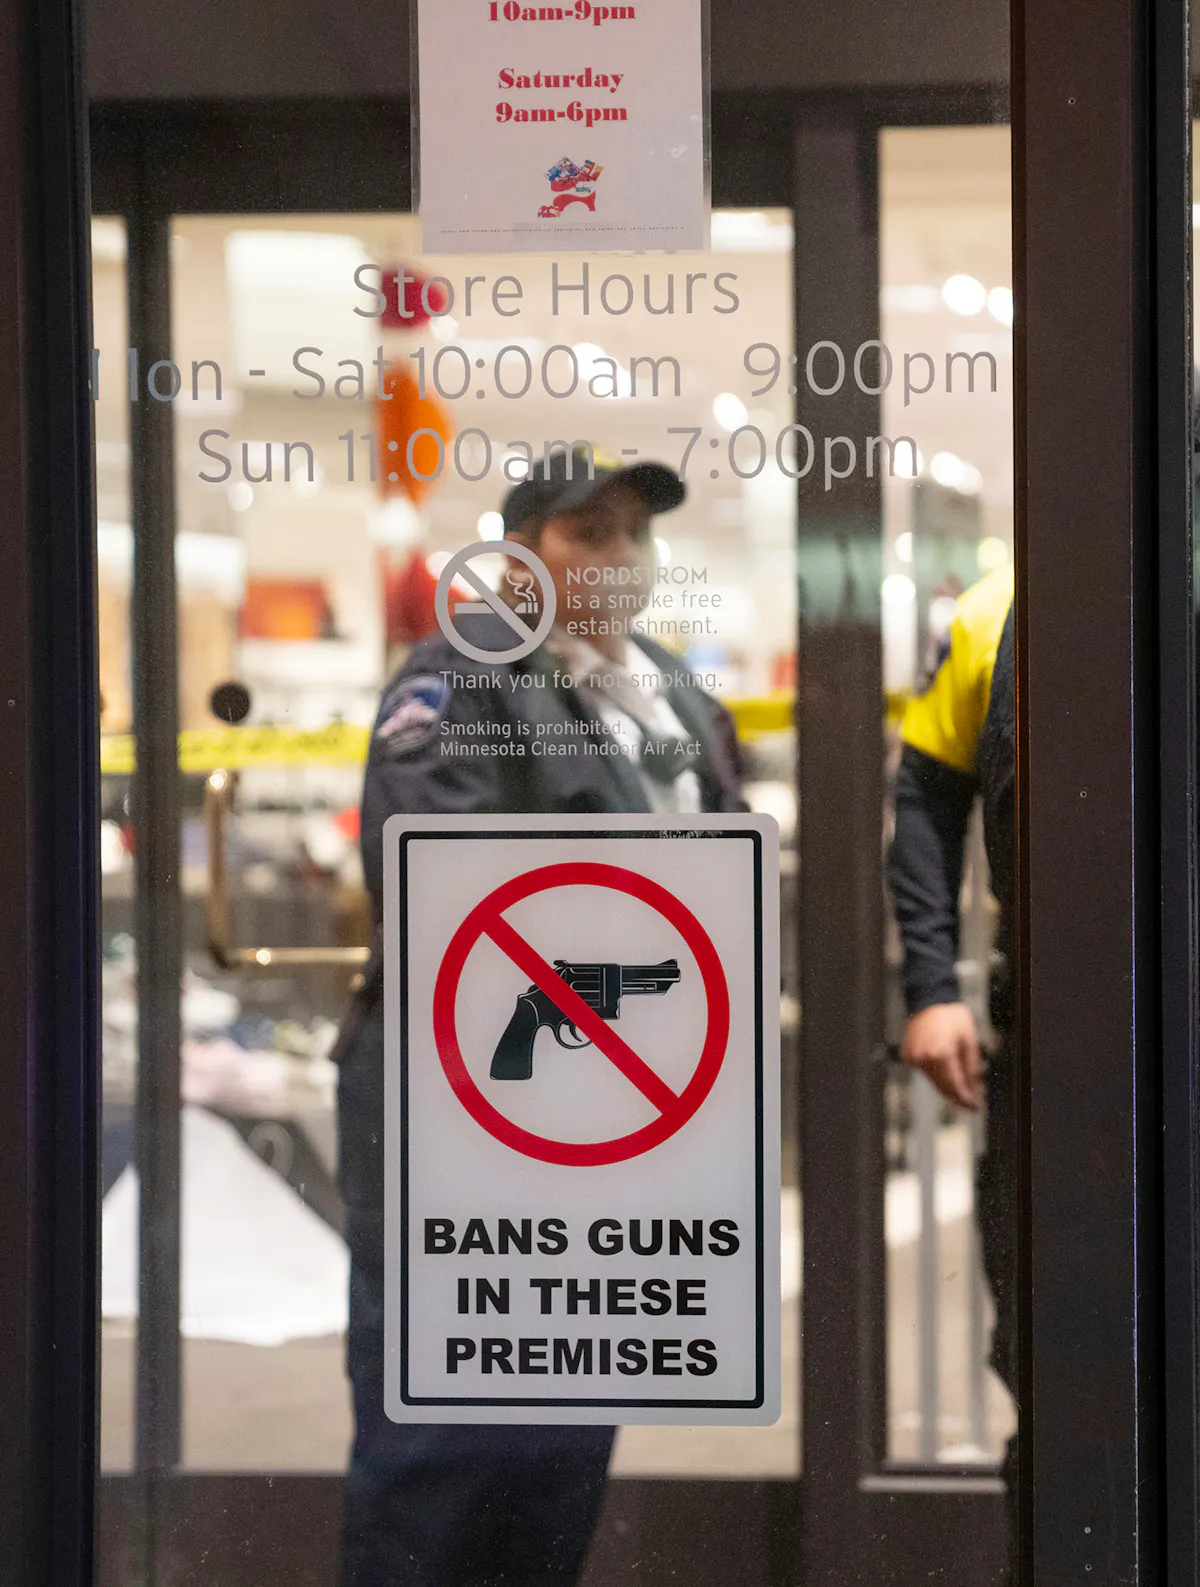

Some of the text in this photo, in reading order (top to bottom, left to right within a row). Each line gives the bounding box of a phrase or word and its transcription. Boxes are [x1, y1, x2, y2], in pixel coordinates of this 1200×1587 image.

[488, 0, 636, 26] 10am-9pm
[498, 67, 624, 93] Saturday
[495, 101, 628, 127] 9am-6pm
[352, 262, 740, 318] Store Hours
[292, 346, 394, 401] Sat
[410, 345, 681, 401] 10:00am
[743, 340, 998, 407] 9:00pm
[197, 428, 315, 483] Sun
[338, 428, 595, 483] 11:00am
[667, 423, 918, 492] 7:00pm
[567, 566, 707, 586] NORDSTROM
[567, 590, 722, 609] is a smoke free
[567, 616, 718, 635] establishment.
[439, 670, 502, 690] Thank
[509, 674, 546, 693] you
[552, 670, 581, 690] for
[631, 670, 723, 692] smoking.
[440, 720, 626, 738] Smoking is prohibited.
[440, 740, 701, 757] Minnesota Clean Indoor Air Act
[424, 1218, 740, 1257] BANS GUNS
[457, 1278, 708, 1316] IN THESE
[445, 1337, 718, 1377] PREMISES
